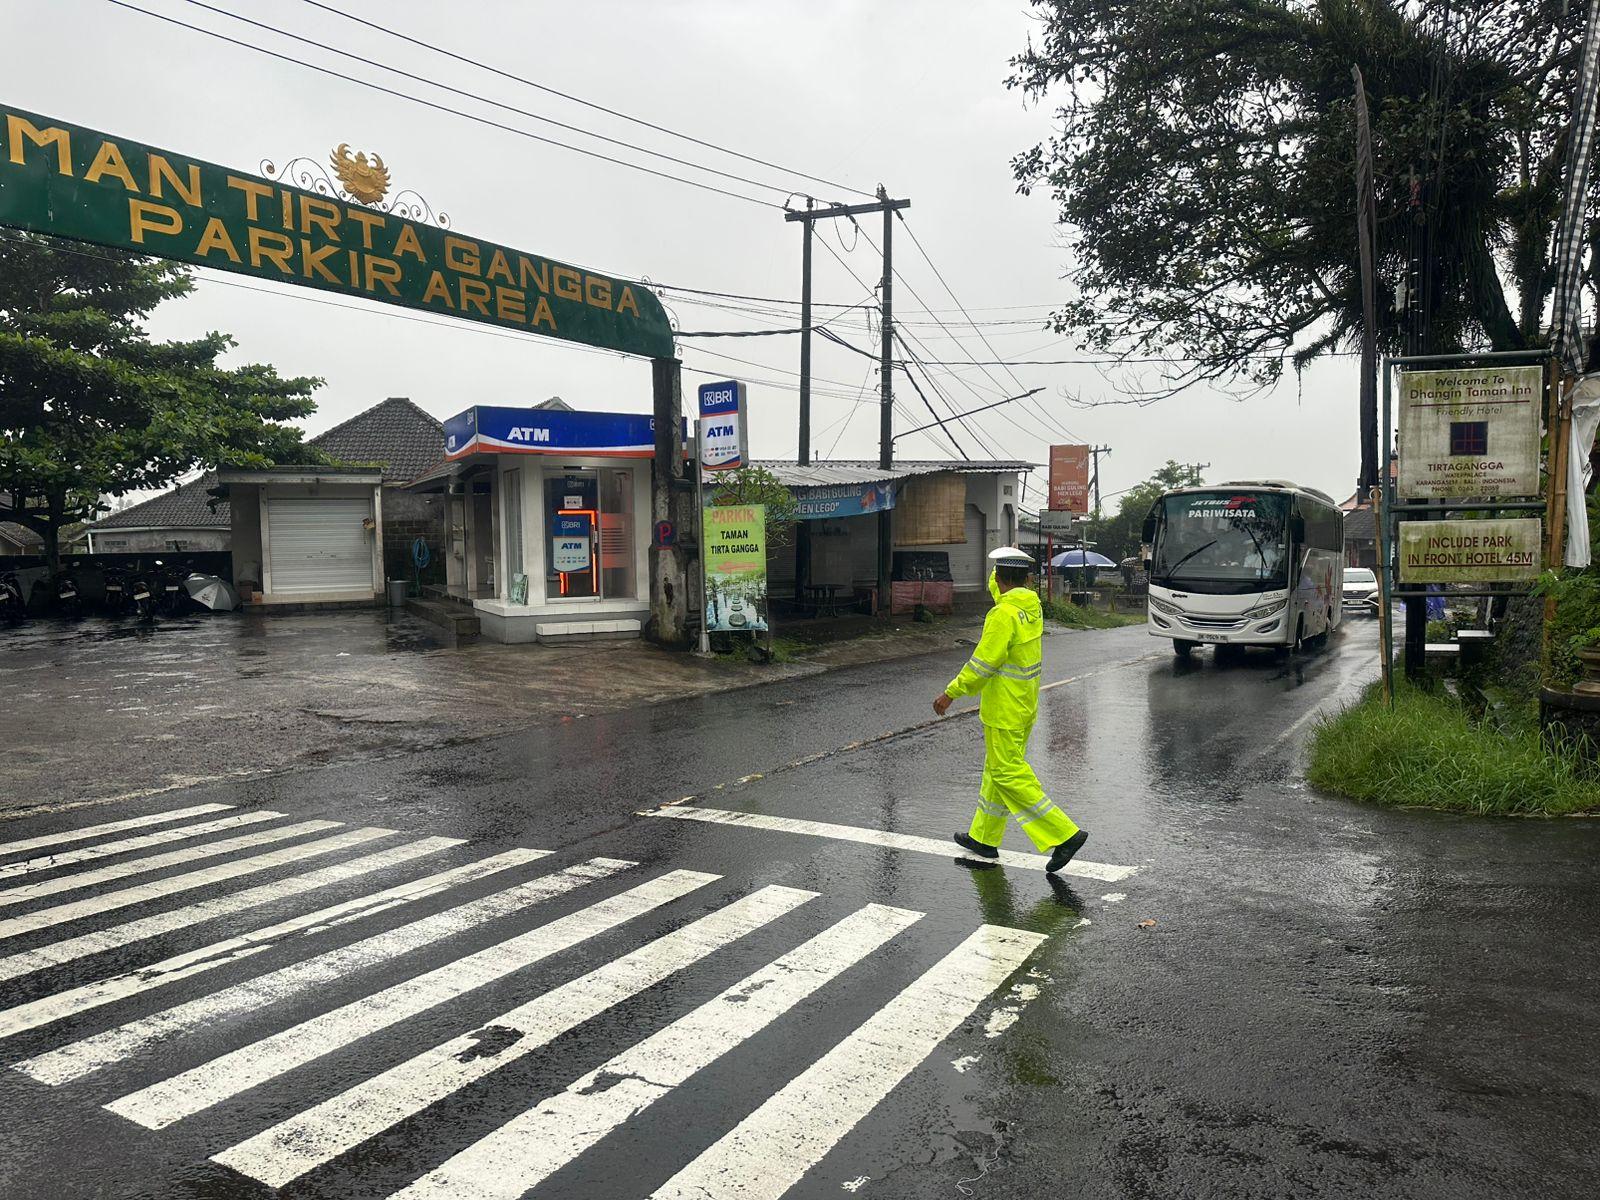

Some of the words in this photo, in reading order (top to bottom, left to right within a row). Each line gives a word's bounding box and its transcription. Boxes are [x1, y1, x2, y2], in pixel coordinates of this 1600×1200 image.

[7, 114, 202, 208] MAN
[227, 175, 427, 263] TIRTA
[444, 235, 640, 317] GANGGA
[128, 198, 402, 297] PARKIR
[422, 271, 557, 330] AREA
[1435, 376, 1488, 387] Welcome
[1493, 376, 1505, 385] To
[715, 389, 733, 404] BRI
[1410, 387, 1461, 400] Dhangin
[1467, 386, 1507, 398] Taman
[1512, 385, 1532, 396] Inn
[1436, 407, 1474, 417] Friendly
[1477, 407, 1502, 416] Hotel
[507, 427, 550, 442] ATM
[706, 425, 734, 438] ATM
[1428, 462, 1504, 472] TIRTAGANGGA
[809, 487, 830, 500] BABI
[832, 485, 861, 499] GULING
[712, 509, 754, 523] PARKIR
[1188, 509, 1256, 518] PARIWISATA
[570, 521, 581, 529] BRI
[659, 523, 673, 544] P
[720, 530, 748, 539] TAMAN
[1428, 537, 1478, 548] INCLUDE
[1483, 536, 1512, 548] PARK
[711, 545, 730, 554] TIRTA
[731, 544, 759, 553] GANGGA
[1408, 554, 1419, 565] IN
[1424, 553, 1462, 565] FRONT
[1466, 553, 1502, 564] HOTEL
[1506, 552, 1533, 563] 45M
